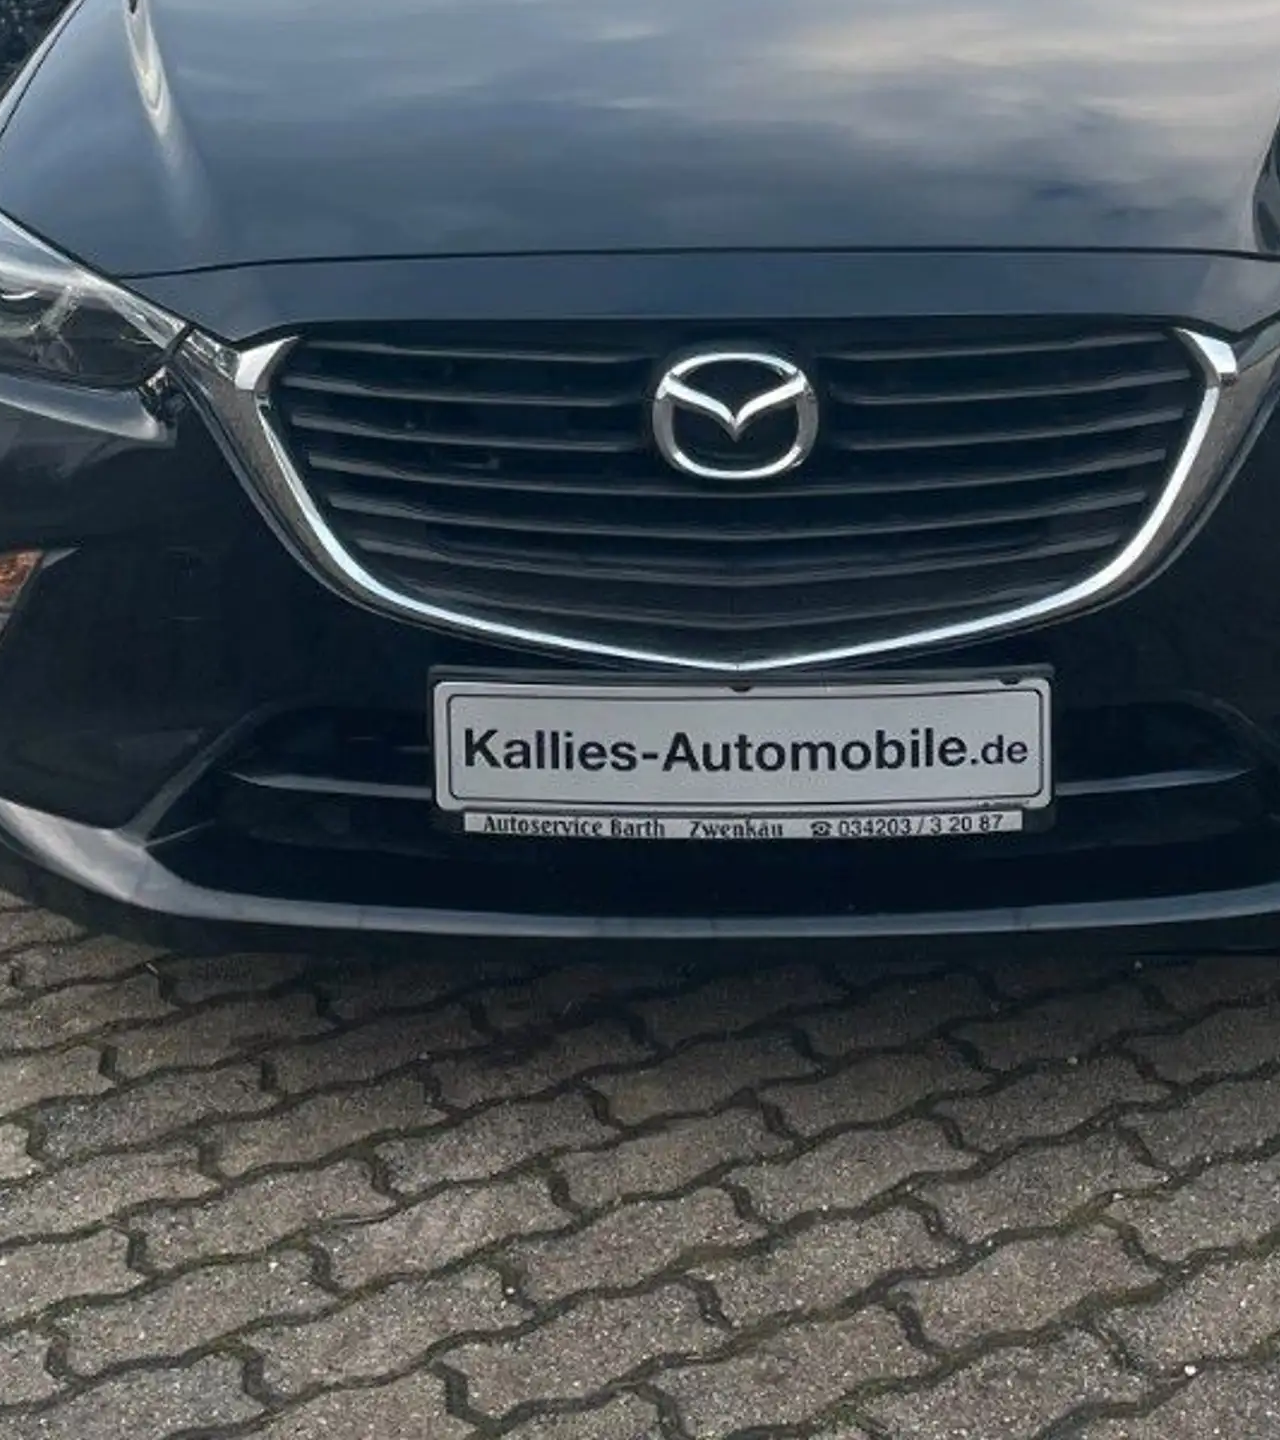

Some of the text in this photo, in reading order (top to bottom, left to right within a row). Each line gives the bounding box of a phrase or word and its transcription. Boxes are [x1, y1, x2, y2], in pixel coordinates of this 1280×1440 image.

[464, 726, 1028, 773] Kallies-Automobile.de
[483, 815, 603, 836] Autoservice
[611, 818, 665, 838] Barth
[838, 818, 912, 836] 034203
